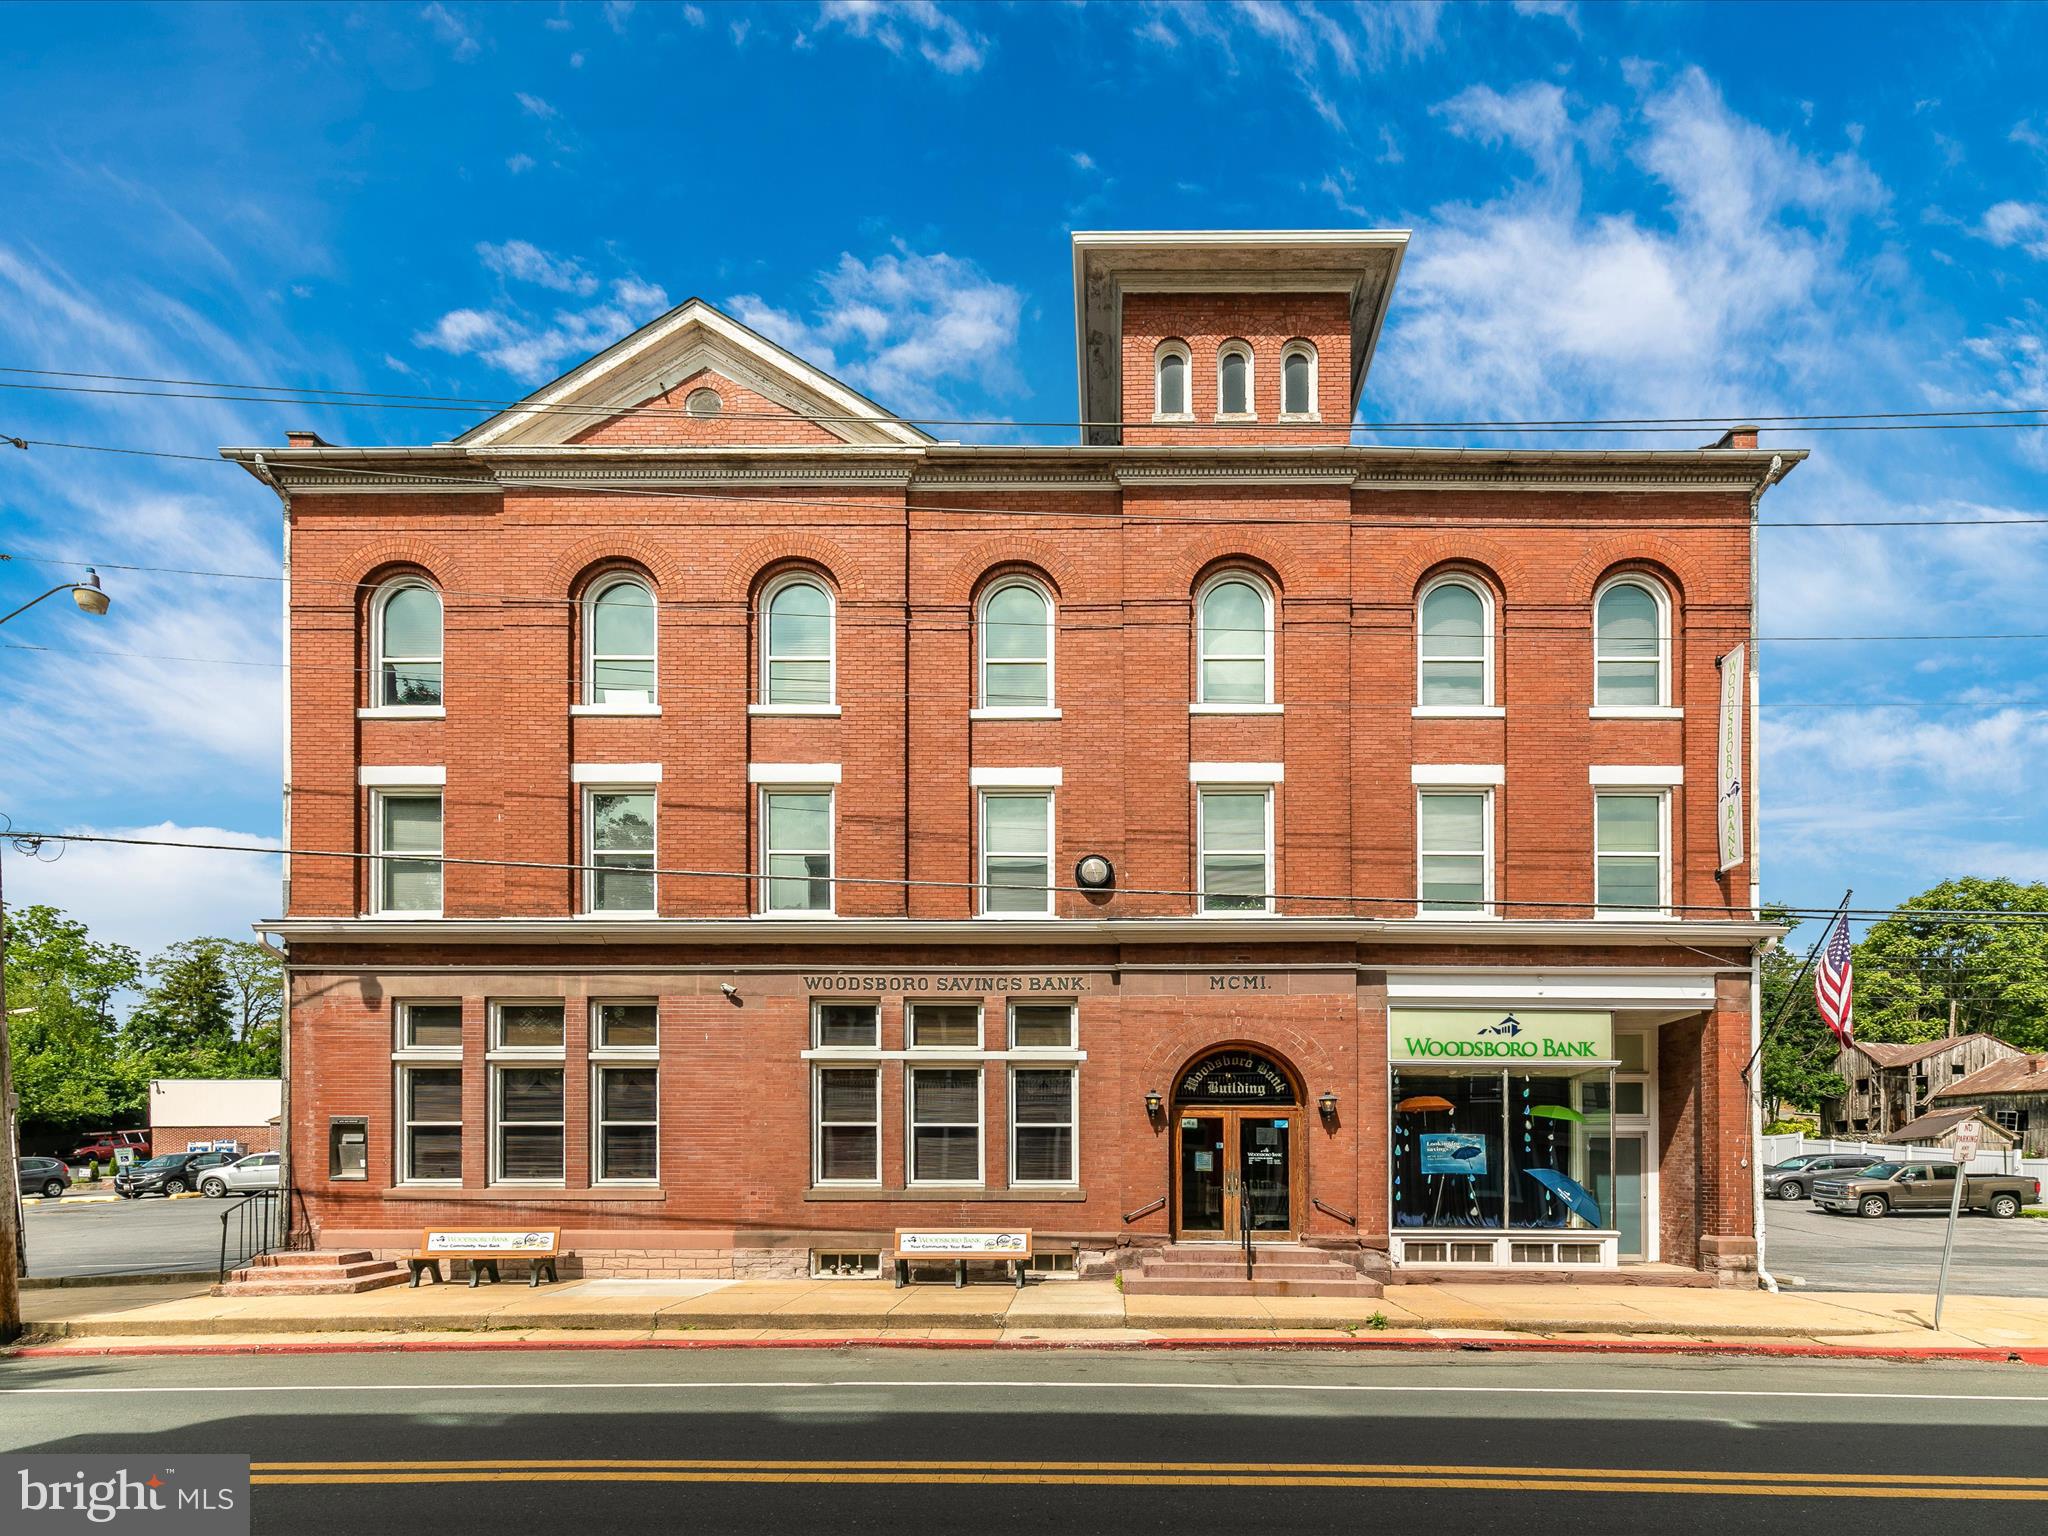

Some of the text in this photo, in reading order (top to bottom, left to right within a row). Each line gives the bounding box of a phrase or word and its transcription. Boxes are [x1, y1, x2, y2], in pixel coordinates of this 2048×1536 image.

[1725, 656, 1738, 779] WOODSBORO
[1727, 804, 1736, 859] BANK
[803, 976, 1091, 991] WOODSBORO SAVINGS BANK.
[1209, 975, 1272, 990] MCMI.
[1184, 1055, 1286, 1094] Woodsboro Bank
[1207, 1081, 1266, 1096] Building
[1964, 1123, 1973, 1132] NO
